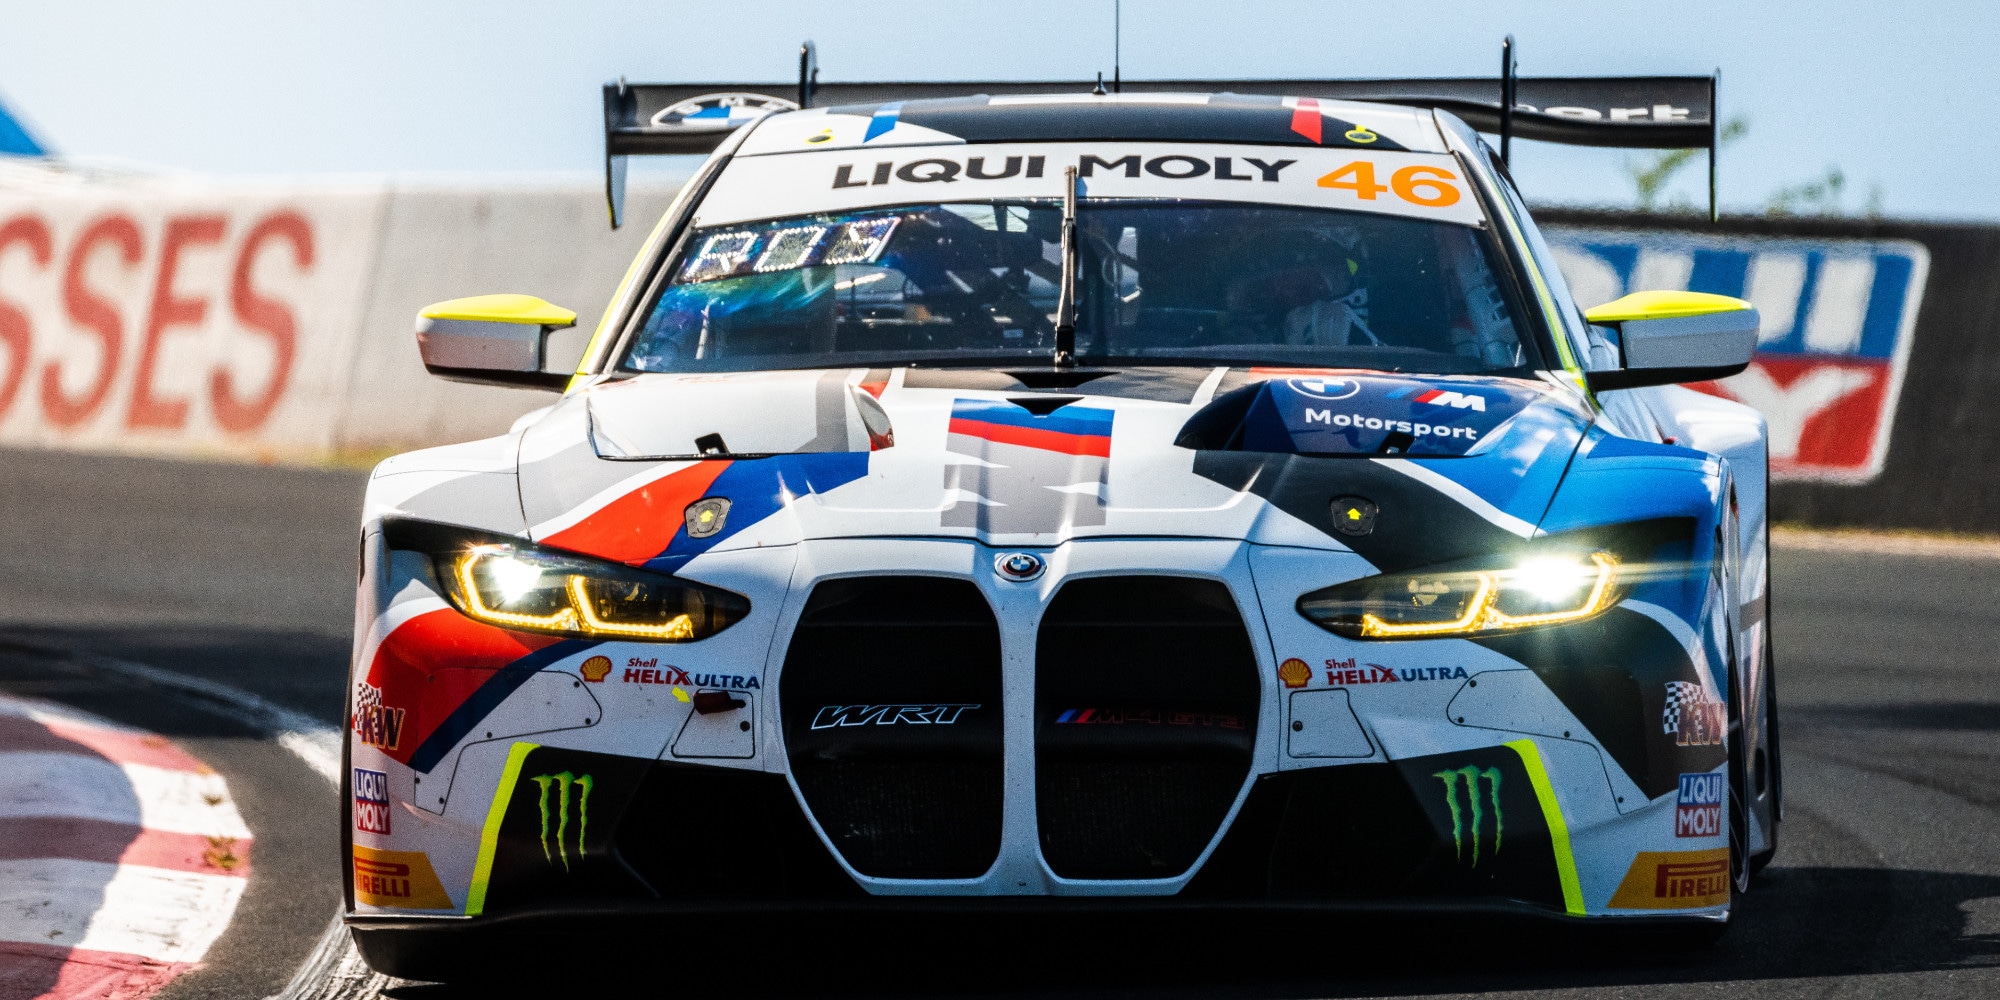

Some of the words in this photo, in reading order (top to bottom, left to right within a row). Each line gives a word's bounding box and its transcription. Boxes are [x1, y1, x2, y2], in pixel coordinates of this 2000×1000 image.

[832, 155, 1046, 189] LIQUI
[1078, 154, 1298, 183] MOLY
[1316, 160, 1461, 208] 46
[684, 217, 889, 279] ROS
[1305, 407, 1478, 440] Motorsport
[627, 657, 658, 668] Shell
[1325, 658, 1356, 669] Shell
[1326, 667, 1400, 686] HELIX
[1401, 666, 1469, 682] ULTRA
[624, 667, 692, 687] HELIX
[694, 673, 761, 690] ULTRA
[361, 705, 405, 750] KW
[811, 703, 982, 730] WRT
[355, 773, 387, 801] LIQUI
[1680, 775, 1723, 804] LIQUI
[357, 802, 389, 832] MOLY
[1678, 807, 1721, 836] MOLY
[1654, 859, 1728, 898] PIRELLI
